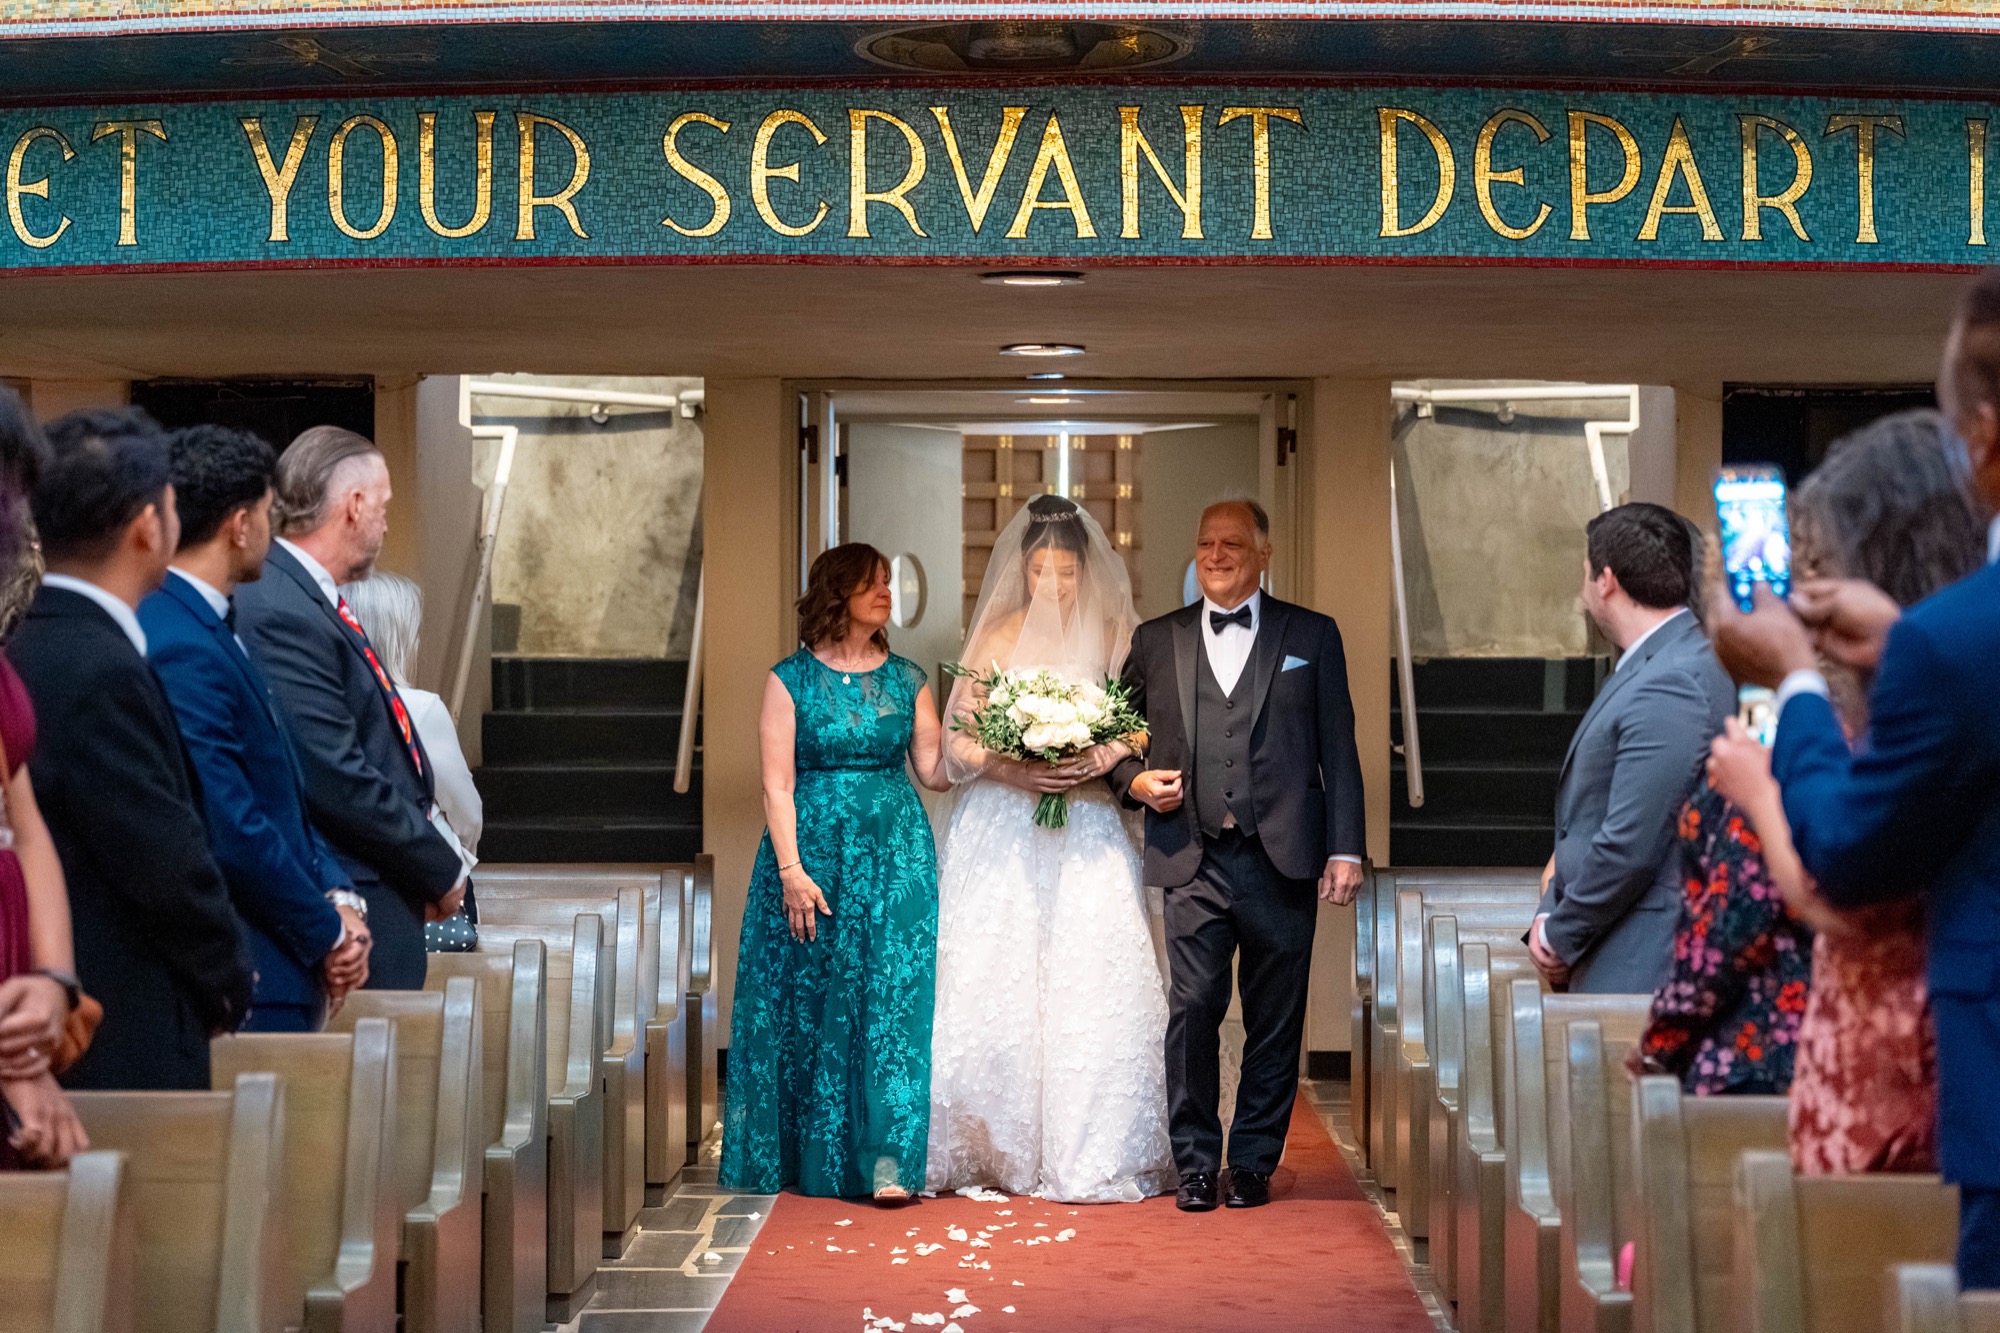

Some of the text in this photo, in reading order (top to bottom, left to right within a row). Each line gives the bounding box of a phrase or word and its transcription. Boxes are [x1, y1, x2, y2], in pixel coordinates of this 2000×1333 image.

[239, 110, 592, 241] YOUR
[661, 105, 1309, 239] SERVANT
[1376, 106, 1906, 244] DEPART
